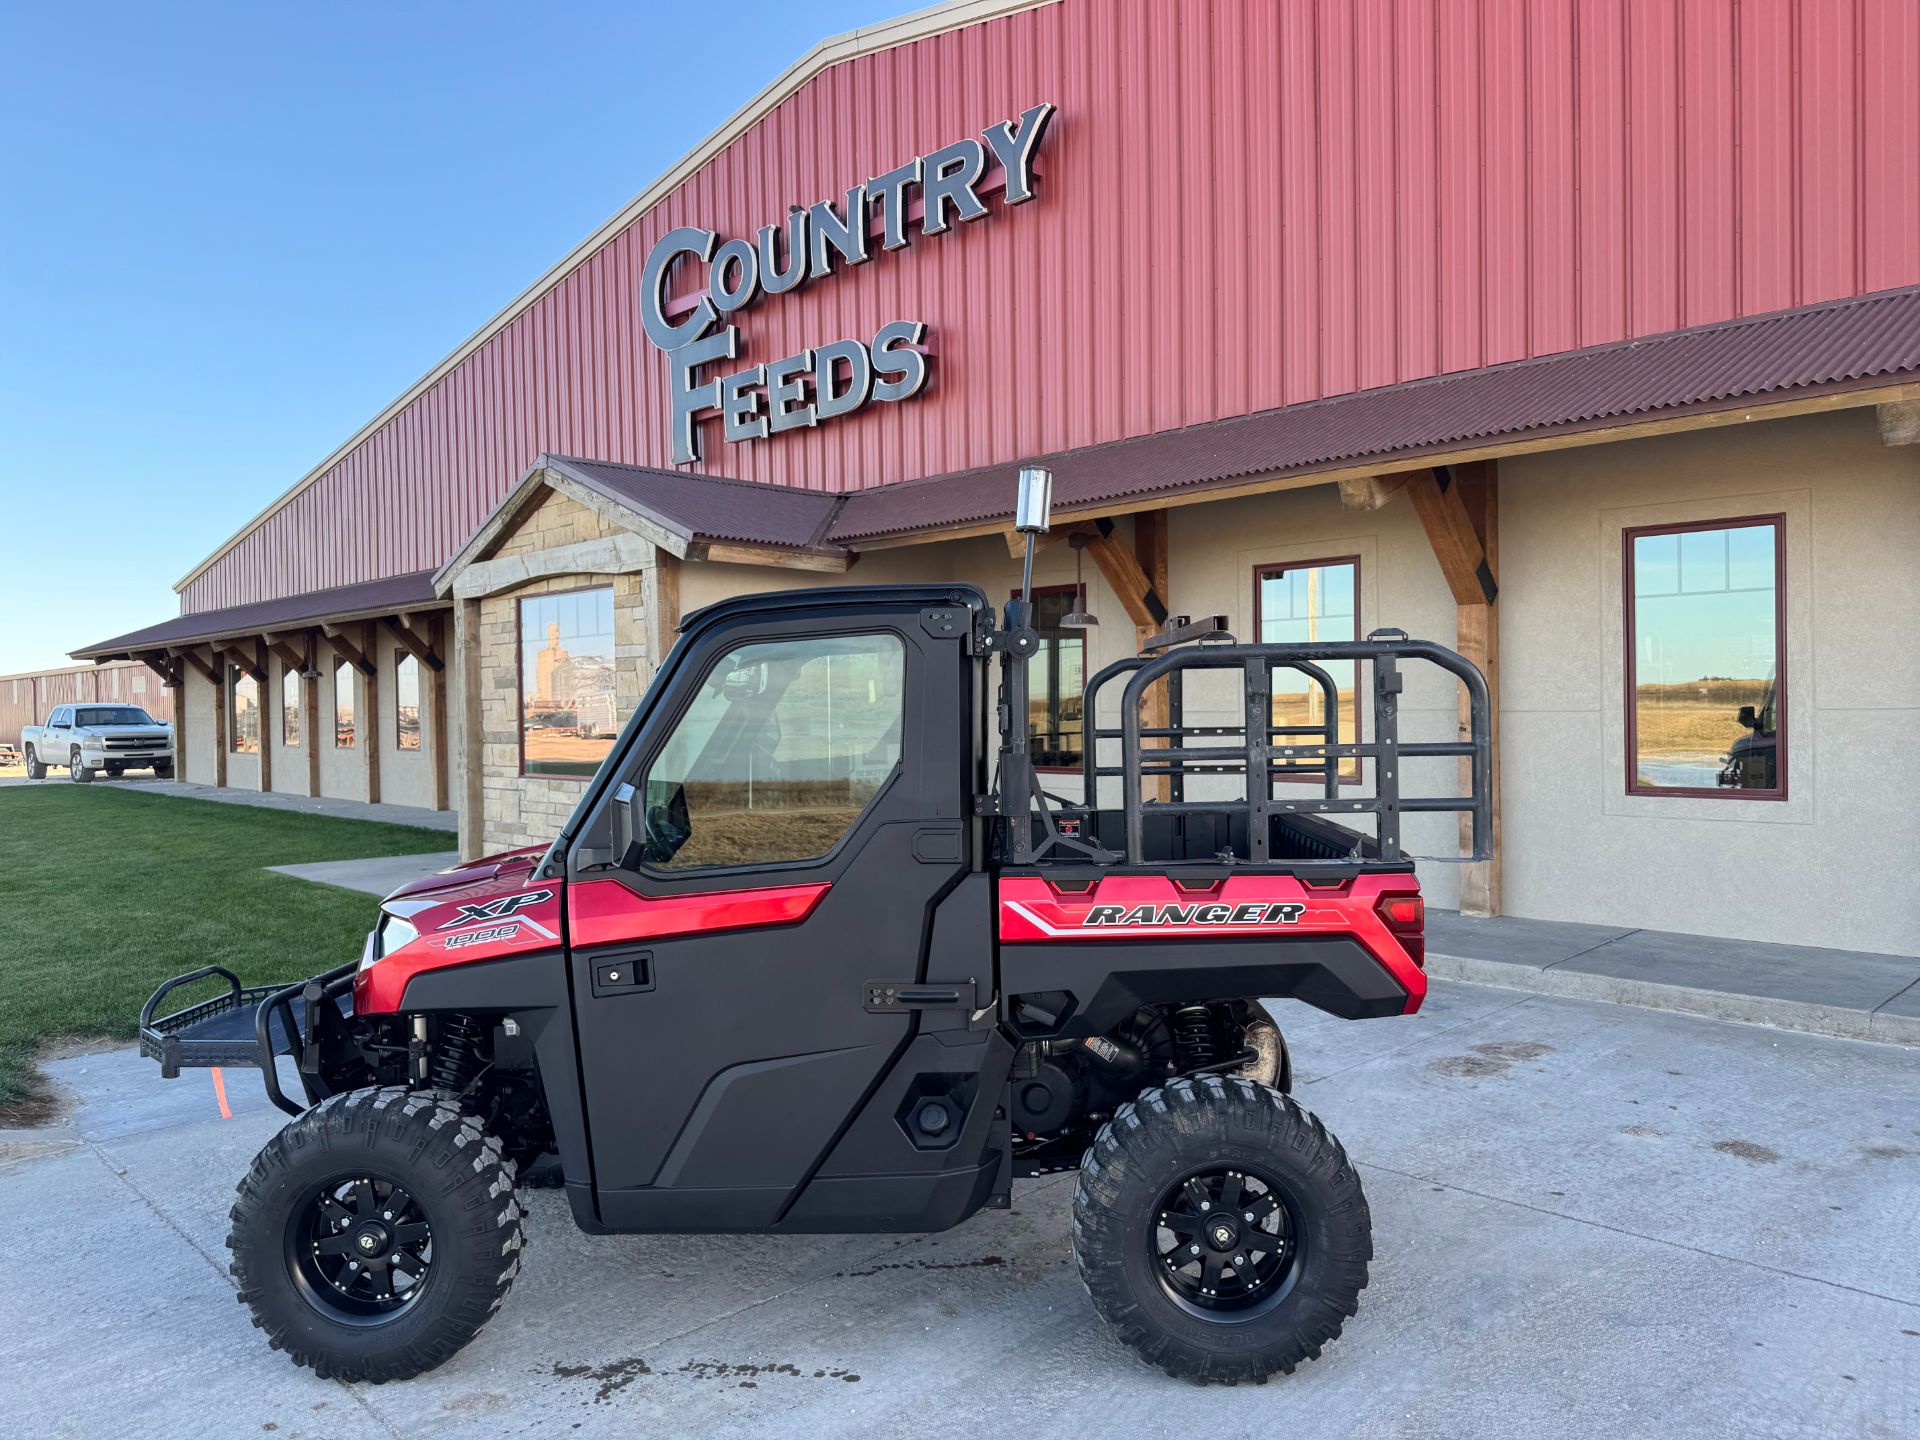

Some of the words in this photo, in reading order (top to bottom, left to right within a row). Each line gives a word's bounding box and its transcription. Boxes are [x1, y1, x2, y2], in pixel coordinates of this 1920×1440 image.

[640, 102, 1056, 352] COUNTRY
[667, 320, 928, 465] FEEDS
[434, 888, 554, 930] XP
[1082, 902, 1306, 927] RANGER
[444, 924, 519, 947] 1000
